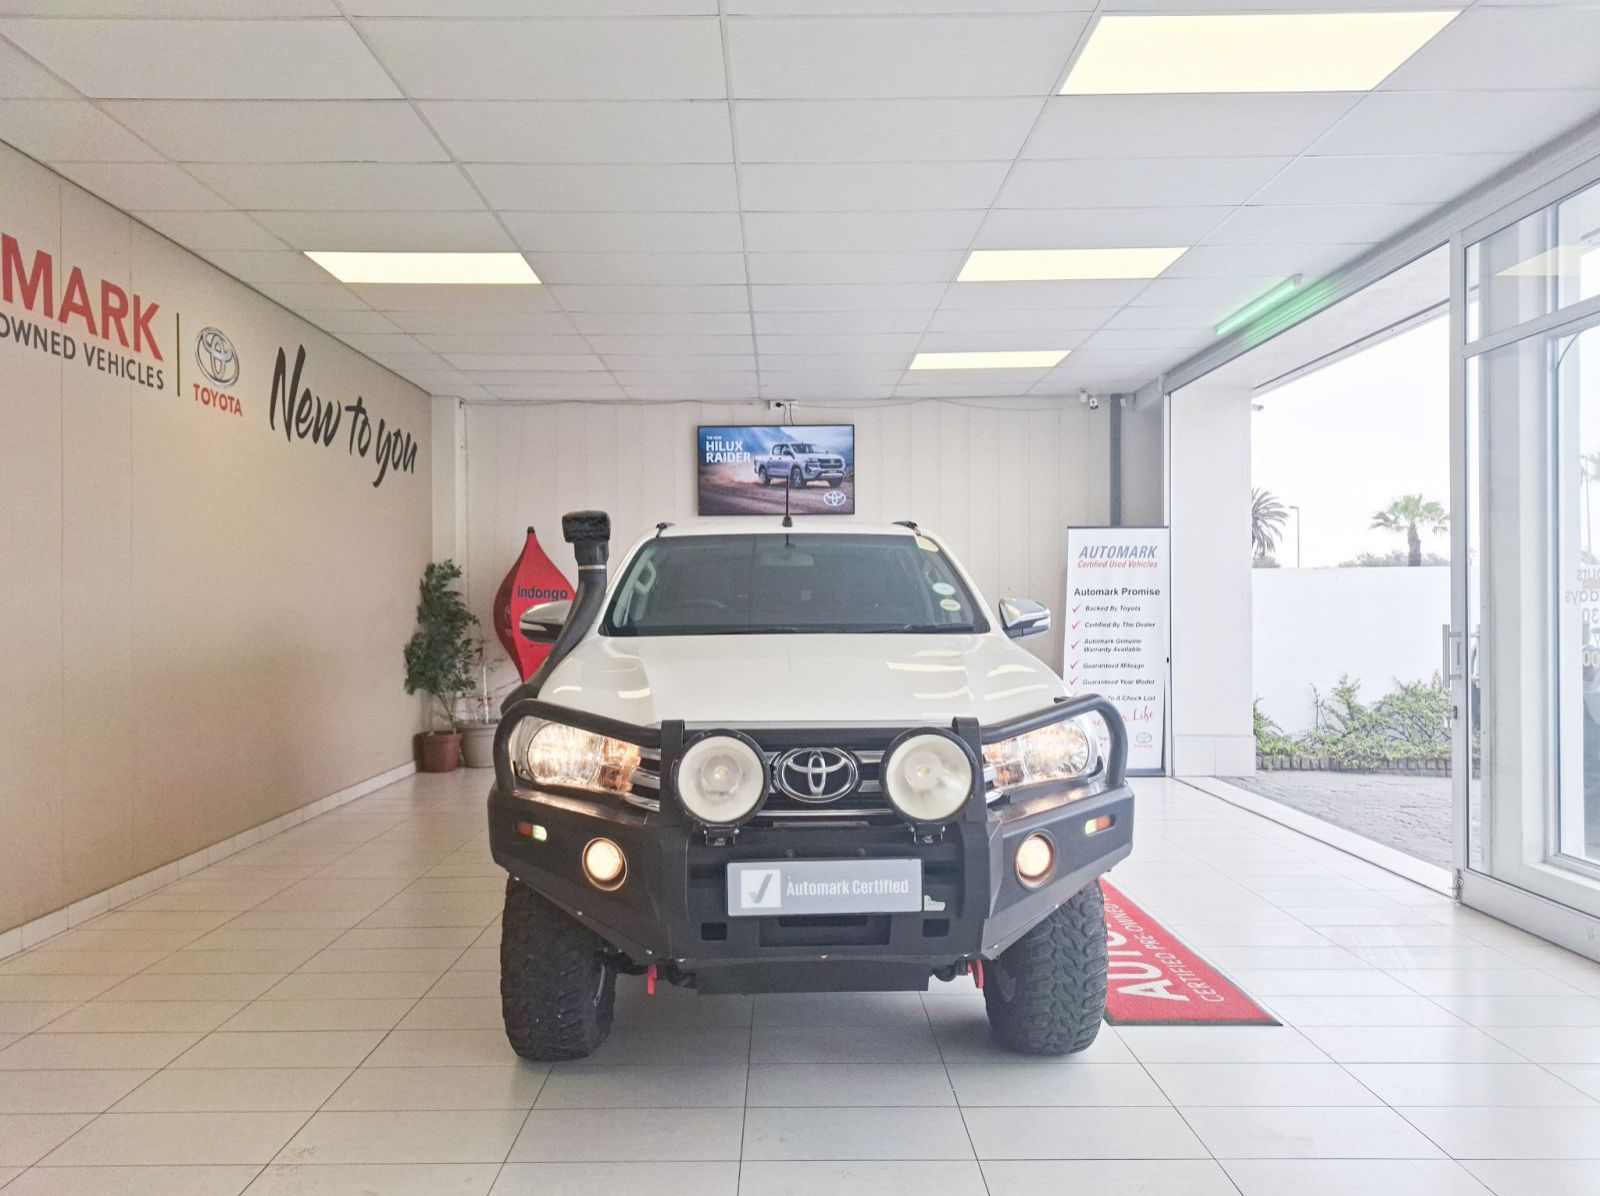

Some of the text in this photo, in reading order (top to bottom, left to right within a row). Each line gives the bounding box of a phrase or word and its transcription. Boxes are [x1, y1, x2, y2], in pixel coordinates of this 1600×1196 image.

[2, 232, 164, 362] MARK
[83, 342, 164, 390] VEHICLES
[193, 383, 243, 417] TOYOTA
[269, 344, 418, 488] New to you
[705, 441, 744, 452] HILUX
[705, 452, 752, 463] RAIDER
[1078, 545, 1158, 559] AUTOMARK
[1077, 560, 1158, 569] Certified Used Vehicles
[517, 585, 569, 602] Indongo
[1073, 587, 1161, 596] Automark Promise
[1110, 605, 1118, 613] By
[1120, 605, 1141, 613] Toyota
[1083, 646, 1112, 654] Warranty
[1119, 662, 1145, 670] Mileage
[786, 878, 909, 897] Automark Certified
[1154, 951, 1225, 1003] CERTIFIED
